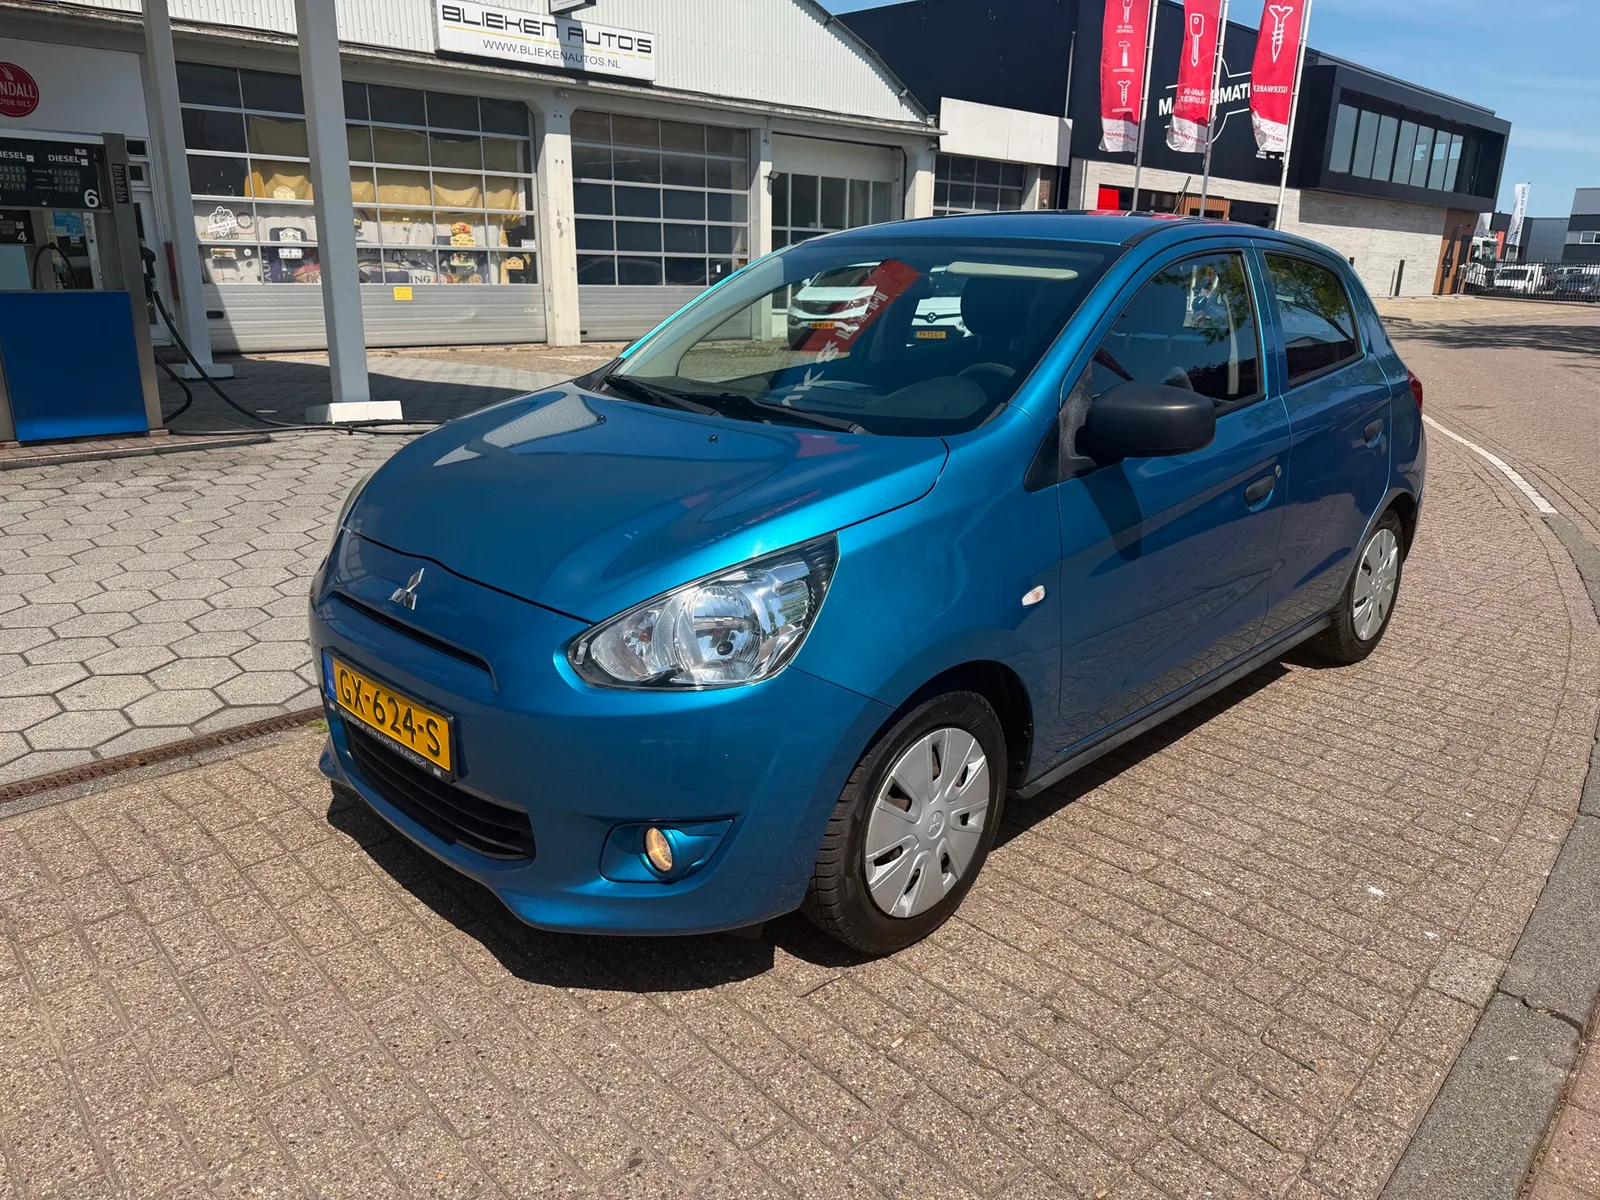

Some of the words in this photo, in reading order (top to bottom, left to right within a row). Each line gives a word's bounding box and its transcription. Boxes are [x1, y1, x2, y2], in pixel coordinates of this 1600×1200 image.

[442, 4, 559, 38] BLIEKEN
[568, 27, 652, 54] AUTO'S
[482, 39, 621, 69] WWW.BLIEKENAUTOS.NL
[0, 81, 36, 98] NDALL
[48, 154, 81, 163] DIESEL
[83, 189, 99, 208] 6
[17, 231, 27, 243] 4
[340, 668, 441, 757] GX-624-S
